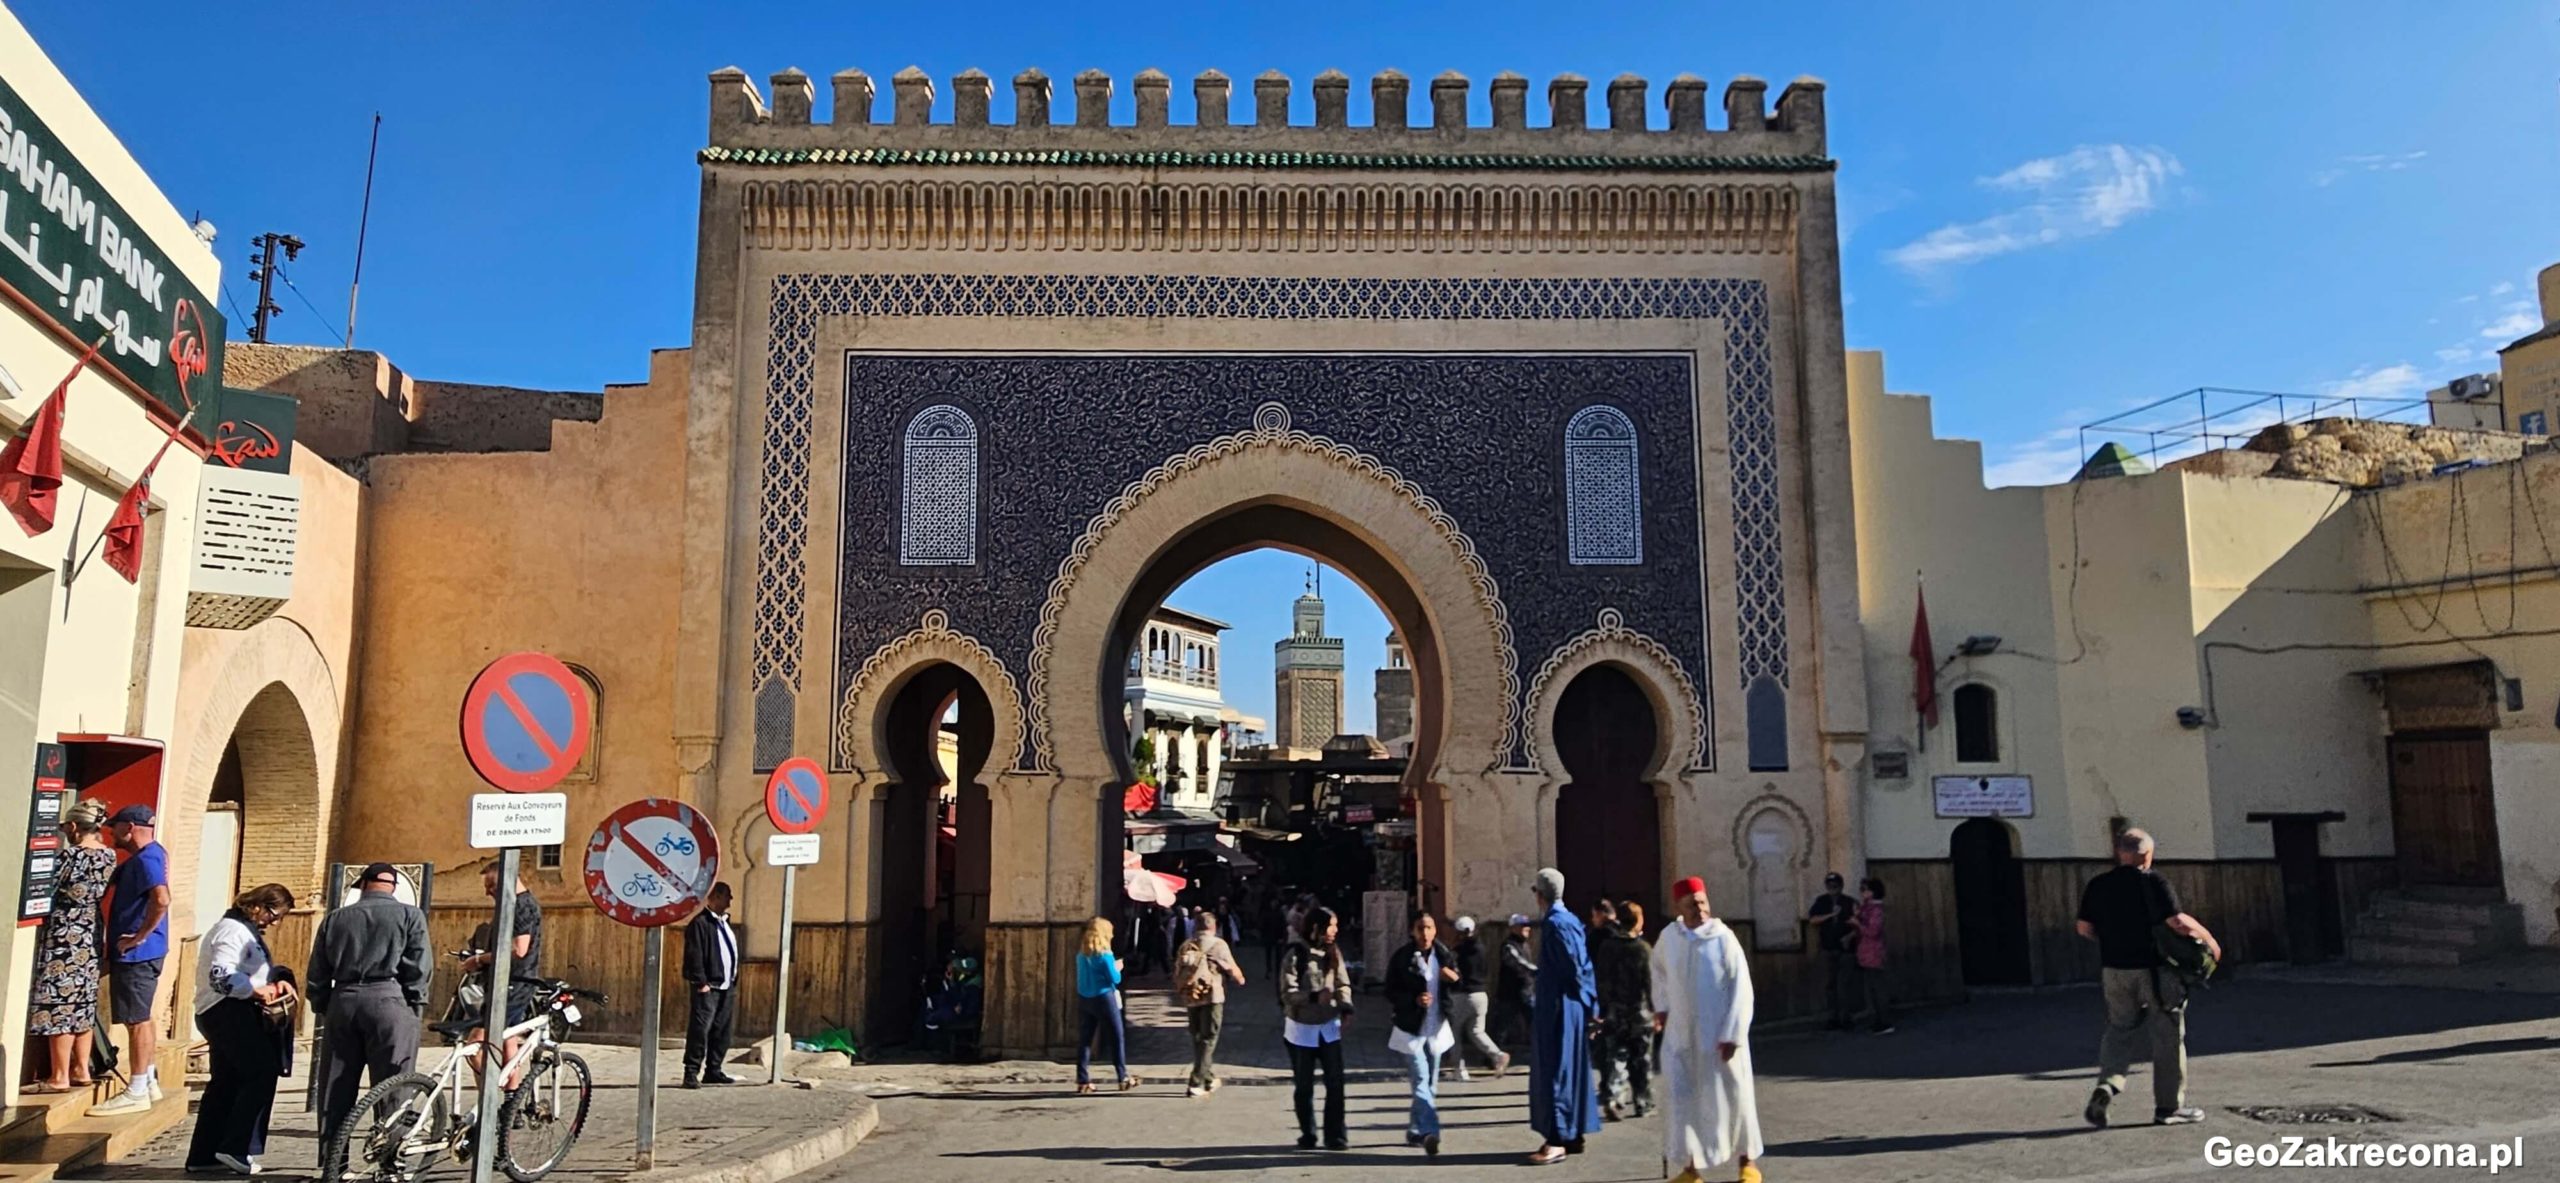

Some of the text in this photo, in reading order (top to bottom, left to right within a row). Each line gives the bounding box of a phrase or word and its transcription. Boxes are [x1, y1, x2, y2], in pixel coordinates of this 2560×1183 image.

[100, 215, 165, 313] BANK
[507, 801, 521, 810] Aux
[522, 801, 562, 811] Convoyeurs
[504, 813, 536, 823] de Fonds
